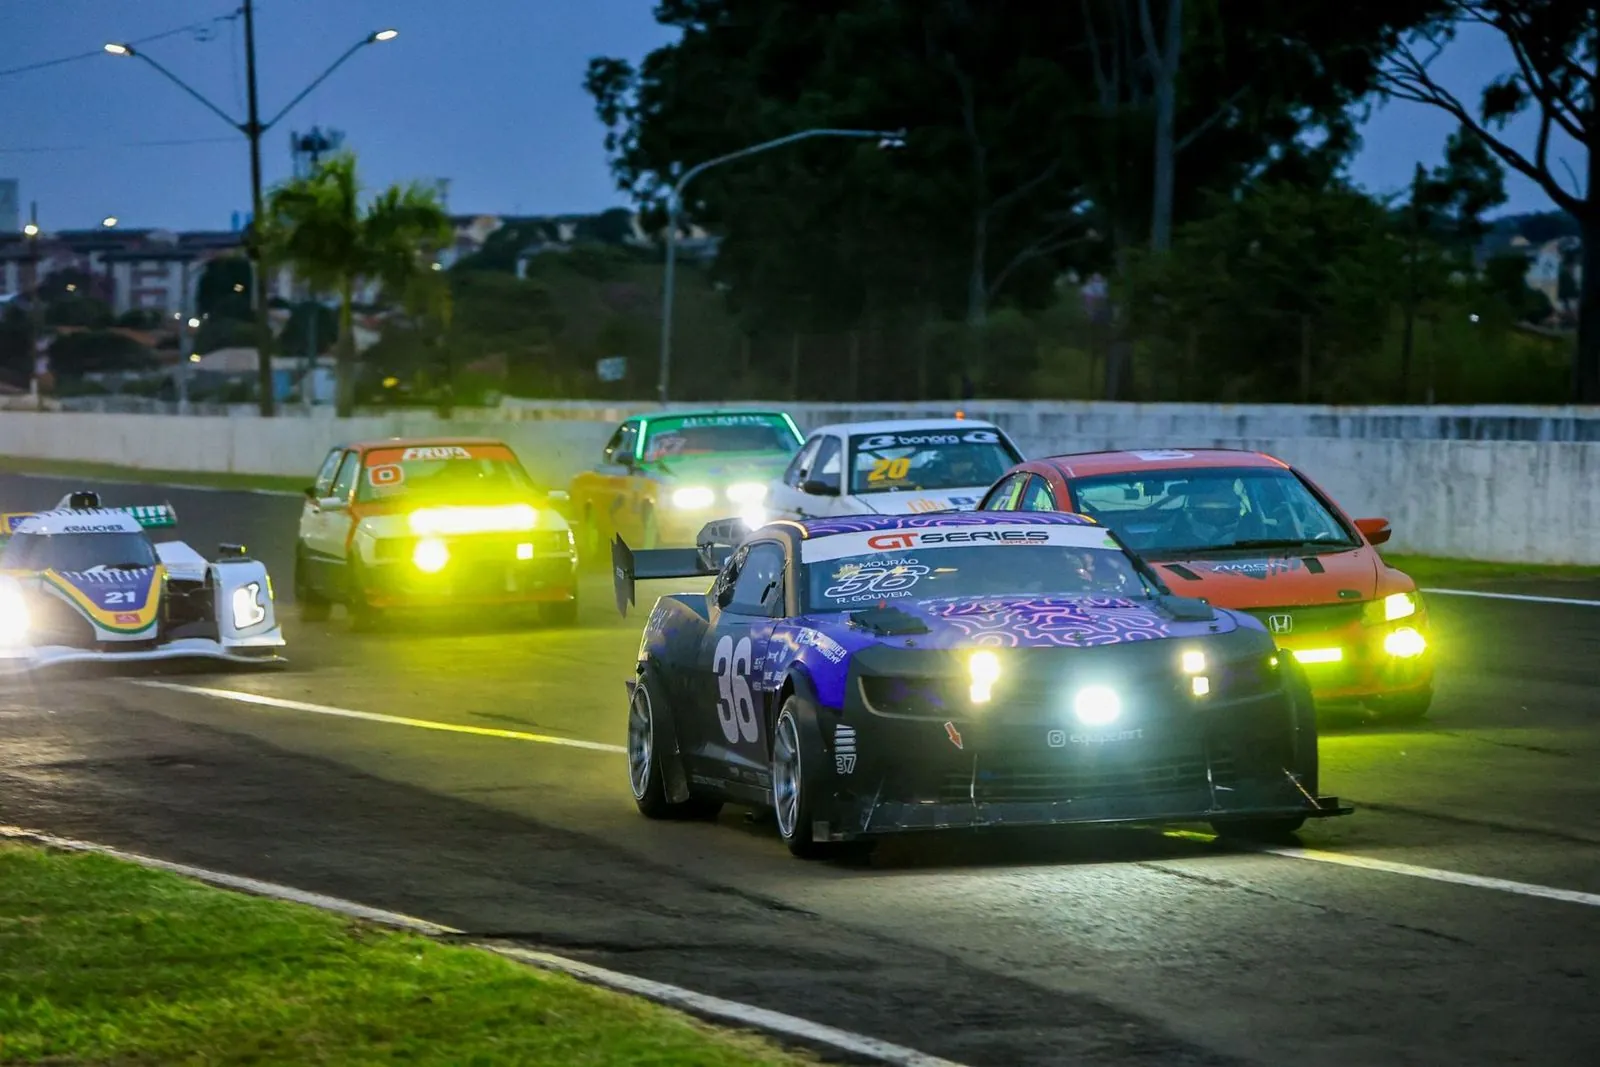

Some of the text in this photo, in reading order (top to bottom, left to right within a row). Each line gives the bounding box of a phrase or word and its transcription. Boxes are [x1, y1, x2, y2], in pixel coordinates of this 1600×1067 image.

[867, 457, 911, 482] 20
[867, 531, 1049, 550] GT SERIES
[860, 557, 919, 569] MOURÃO
[104, 591, 136, 604] 21
[836, 590, 913, 605] R. GOUVEIA
[713, 635, 759, 744] 36
[836, 753, 857, 774] 37
